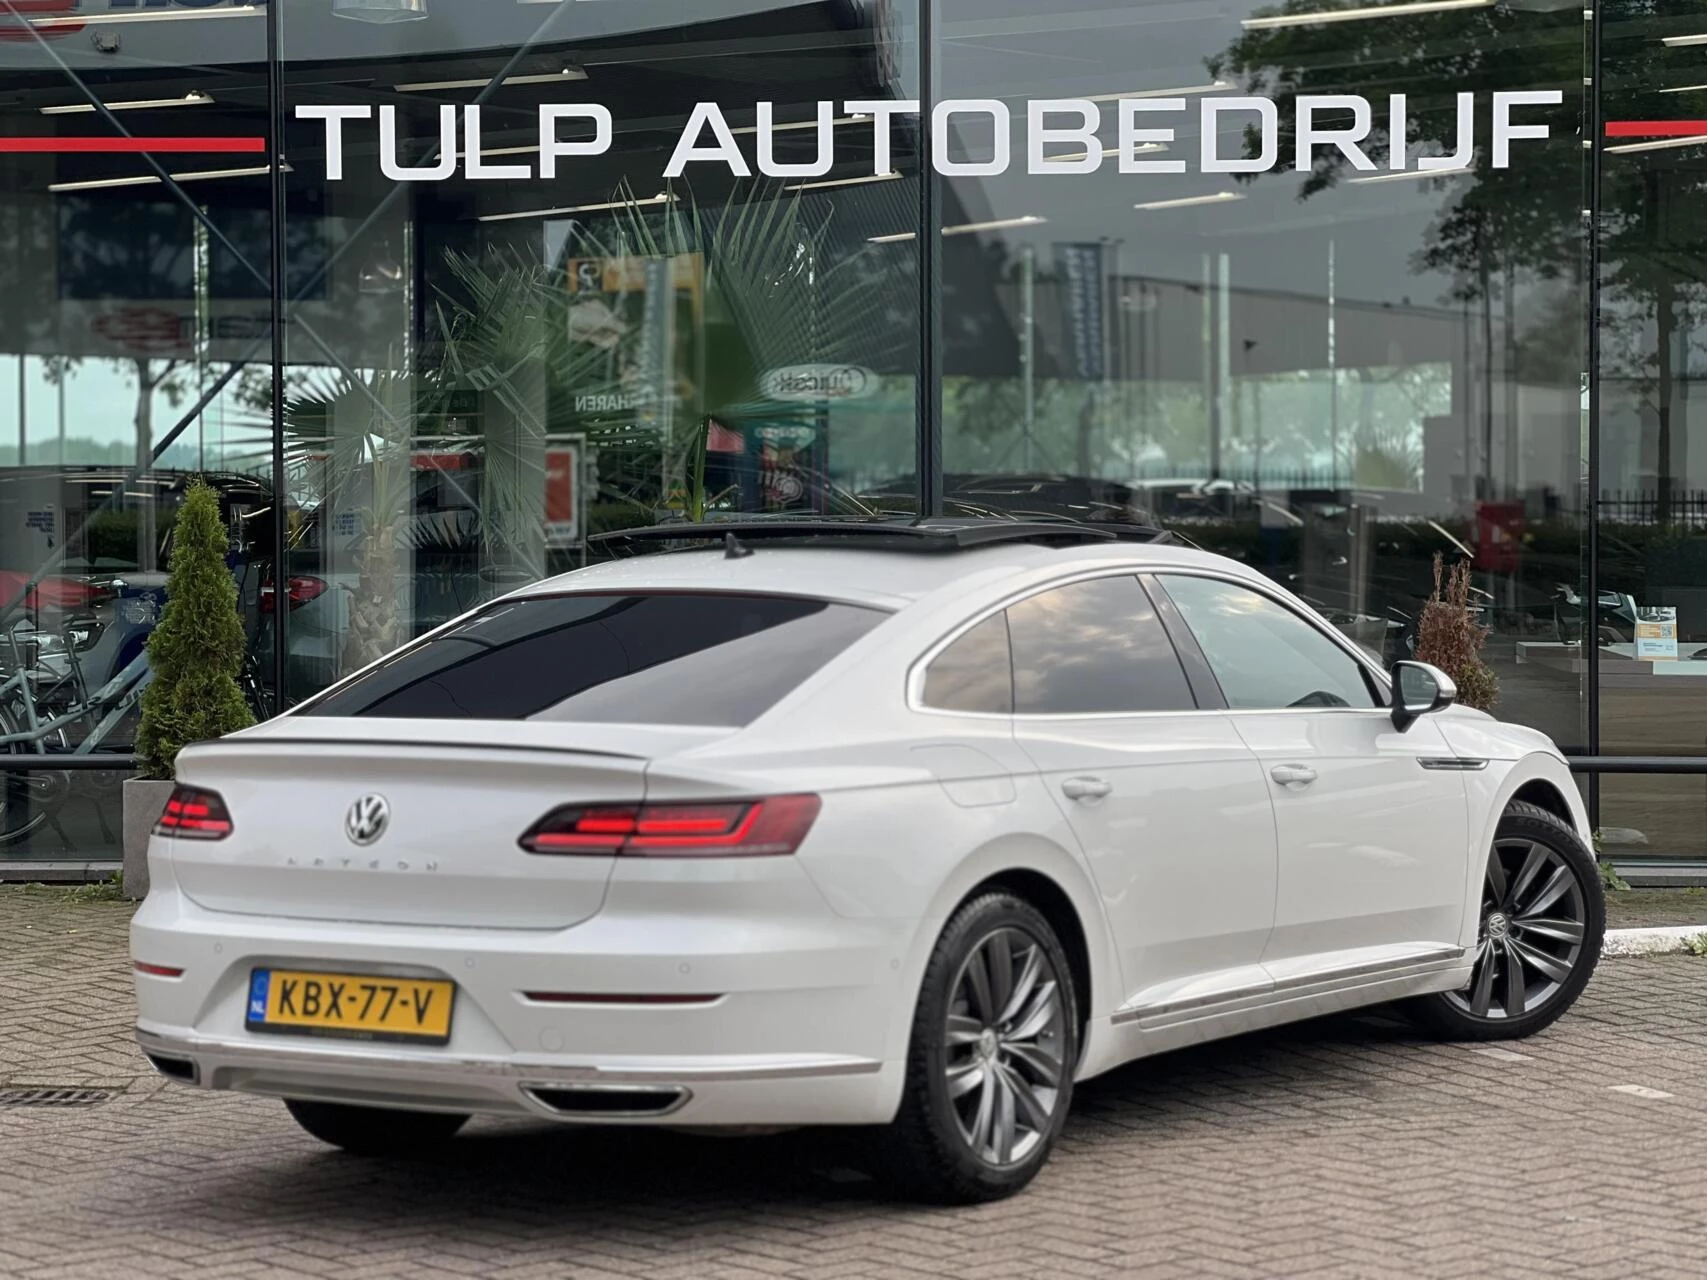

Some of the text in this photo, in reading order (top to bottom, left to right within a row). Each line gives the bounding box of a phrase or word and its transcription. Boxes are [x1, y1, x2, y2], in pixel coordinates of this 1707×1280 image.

[295, 91, 1563, 180] TULP AUTOBEDRIJF
[251, 979, 434, 1026] NL KBX-77-V
